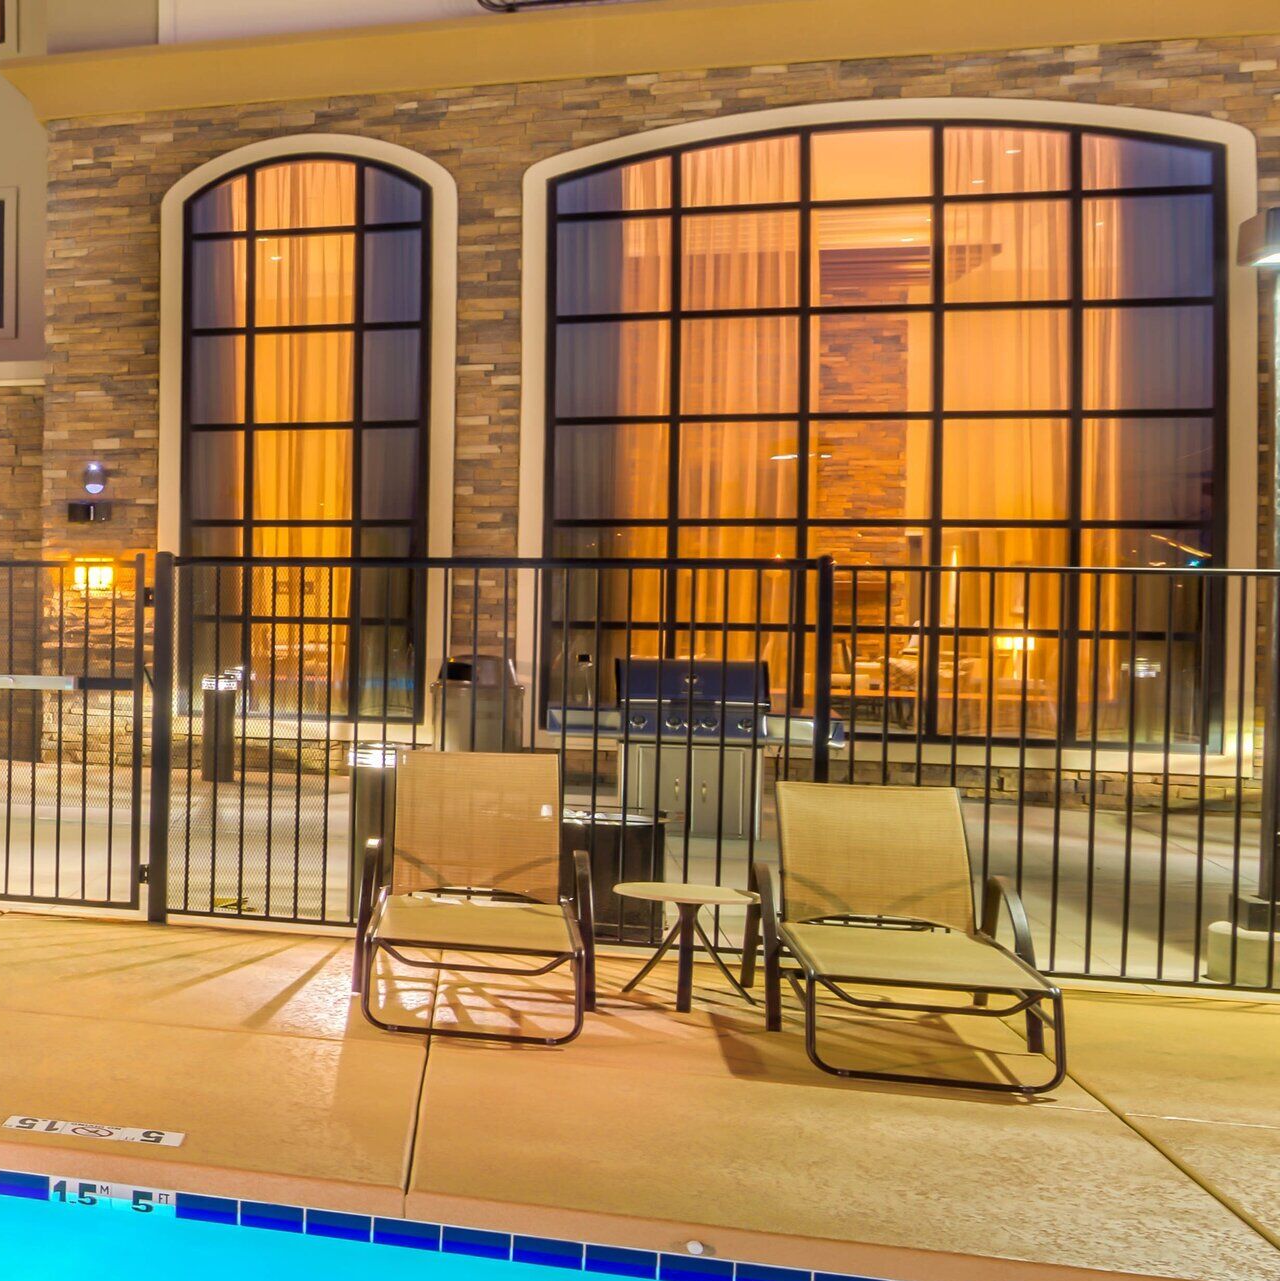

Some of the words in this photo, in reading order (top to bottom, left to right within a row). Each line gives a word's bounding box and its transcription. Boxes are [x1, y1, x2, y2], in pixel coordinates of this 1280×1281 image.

[140, 1130, 165, 1143] 5
[53, 1180, 98, 1206] 1.5
[100, 1185, 109, 1195] M
[131, 1190, 154, 1213] 5
[158, 1193, 170, 1204] FT
